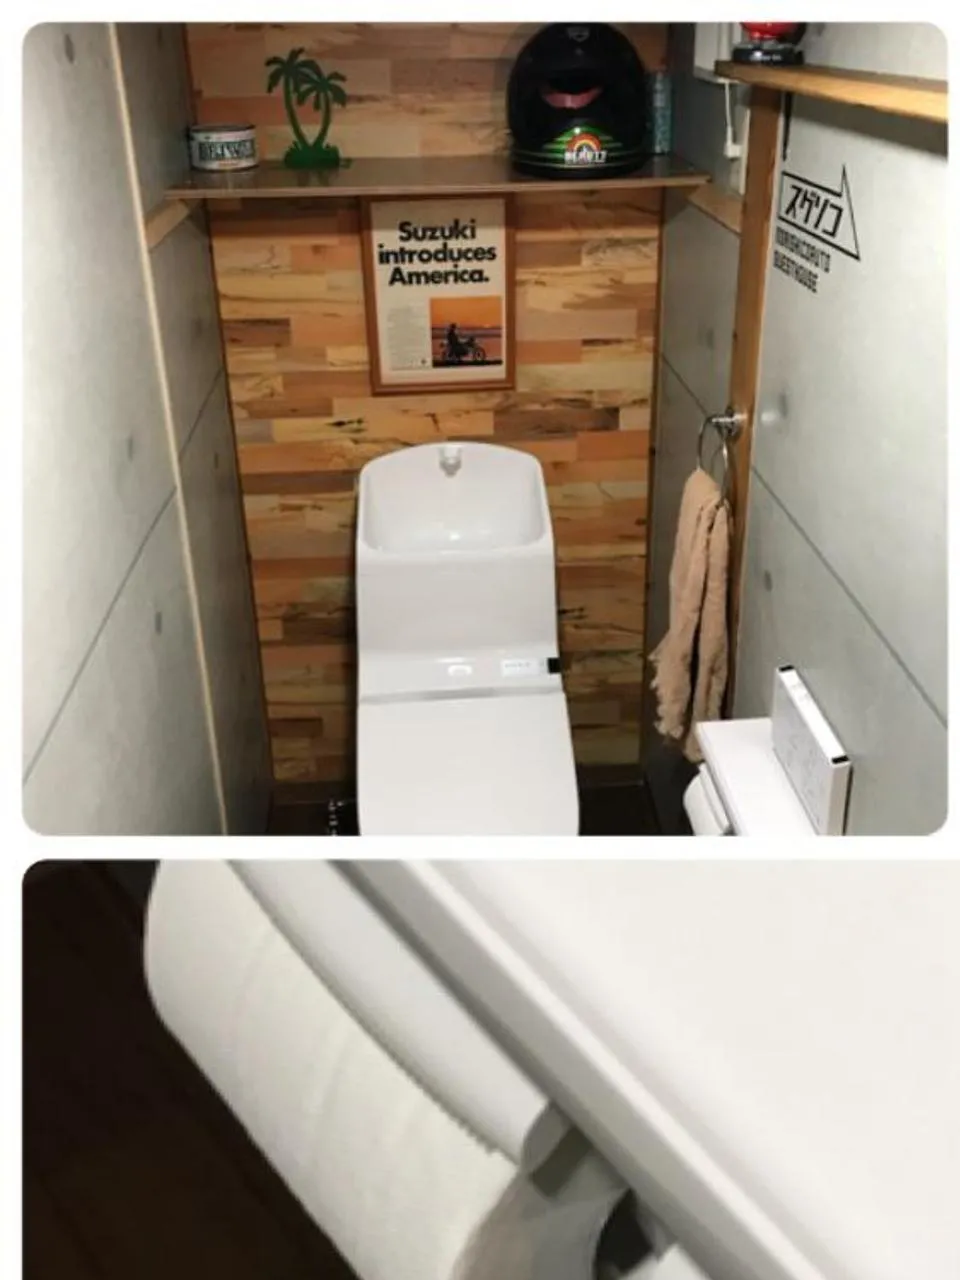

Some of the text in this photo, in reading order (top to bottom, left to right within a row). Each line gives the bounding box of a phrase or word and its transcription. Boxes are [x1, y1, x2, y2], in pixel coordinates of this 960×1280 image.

[398, 219, 477, 242] Suzuki
[377, 242, 497, 265] introduces
[388, 263, 490, 286] America.
